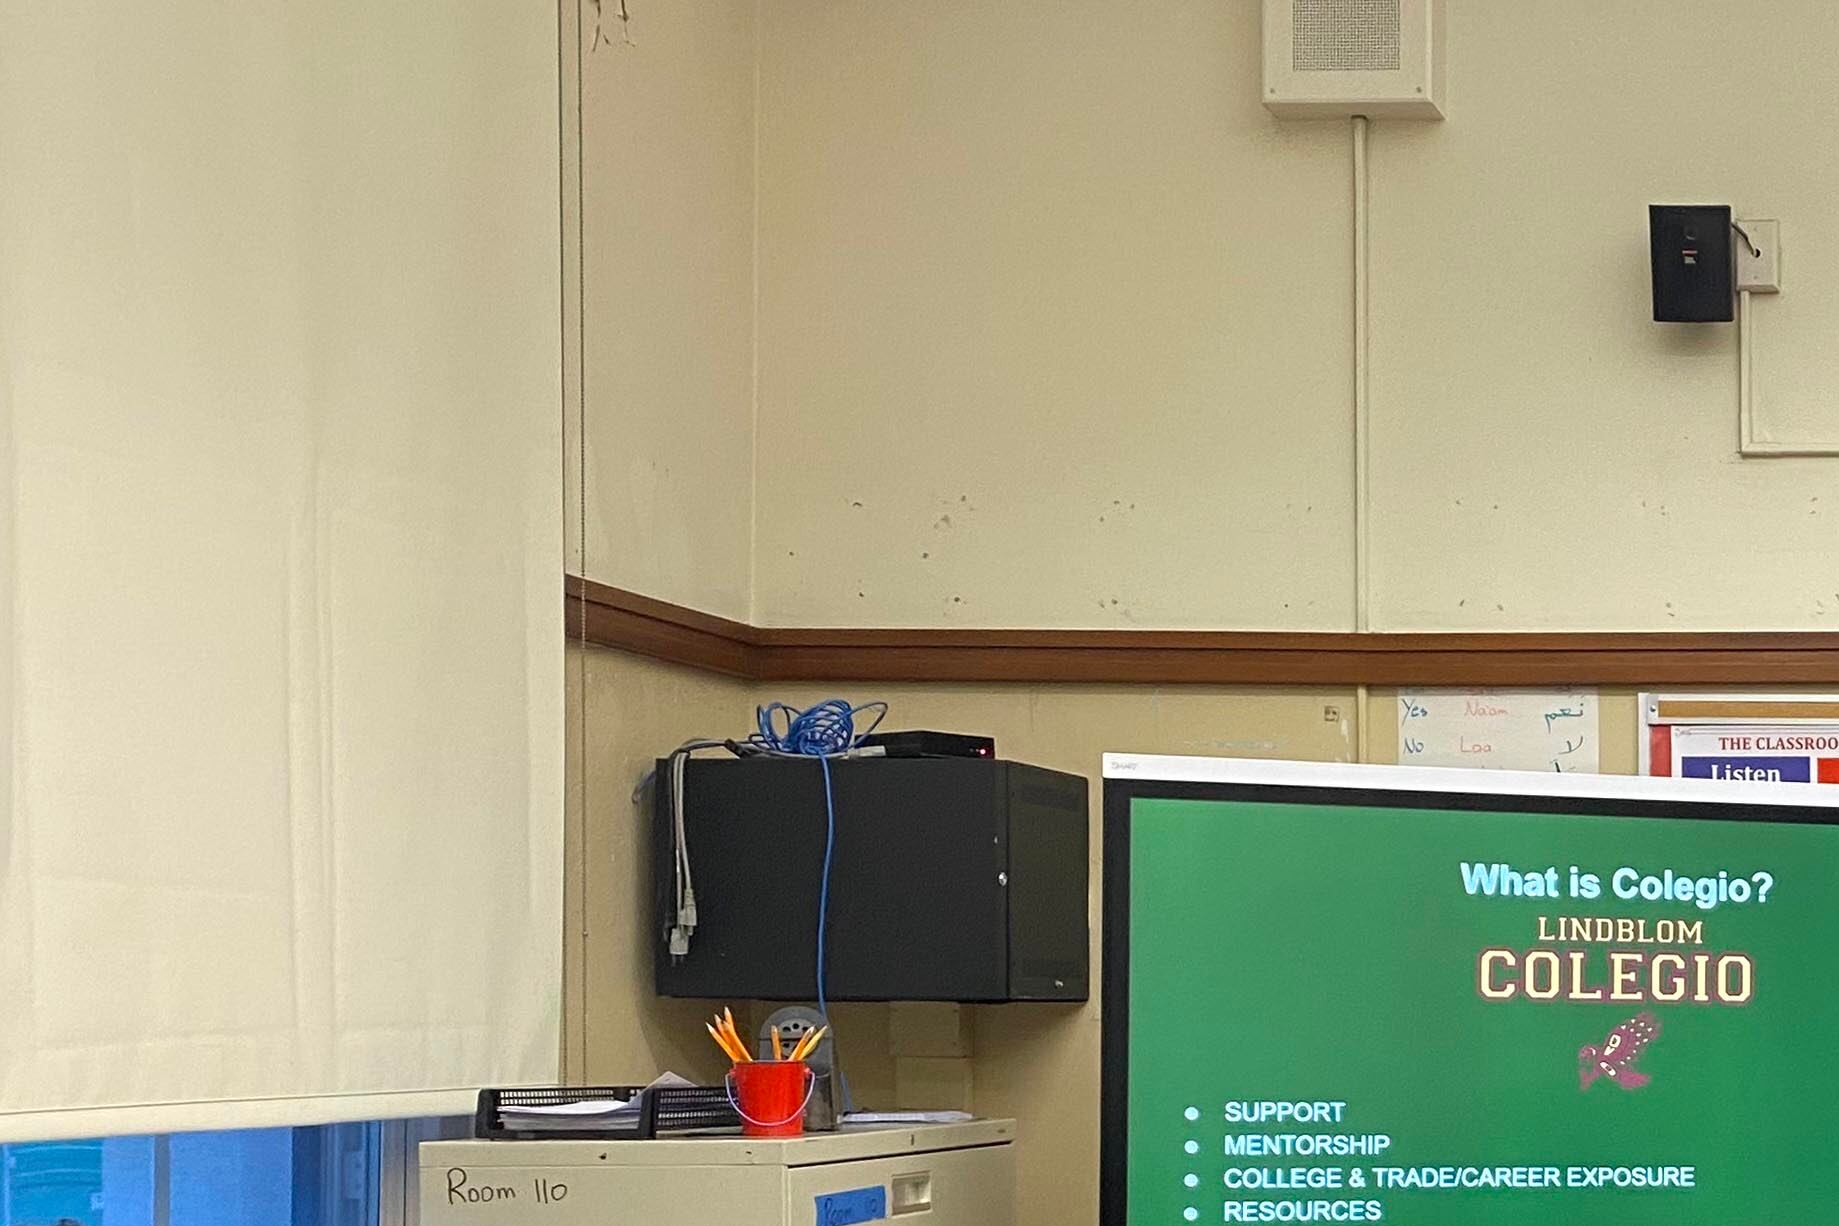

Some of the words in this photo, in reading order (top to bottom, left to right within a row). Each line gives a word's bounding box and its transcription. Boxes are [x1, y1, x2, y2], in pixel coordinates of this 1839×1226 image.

[1401, 698, 1428, 726] Yes
[1544, 702, 1584, 733] نعم
[1403, 737, 1424, 754] No
[1558, 735, 1583, 755] لا
[1718, 736, 1751, 750] THE
[1711, 764, 1781, 783] Listen
[1460, 862, 1559, 897] What
[1569, 866, 1600, 898] is
[1612, 867, 1774, 909] Colegio?
[1538, 916, 1703, 944] LINDBLOM
[1478, 948, 1754, 1003] COLEGIO
[1224, 1101, 1346, 1123] SUPPORT
[1224, 1134, 1391, 1156] MENTORSHIP
[447, 1167, 516, 1205] Room
[1223, 1167, 1343, 1189] COLLEGE
[1348, 1167, 1366, 1188] &
[1372, 1167, 1561, 1189] TRADE/CAREER
[1566, 1166, 1696, 1188] EXPOSURE
[1223, 1200, 1383, 1222] RESOURCES
